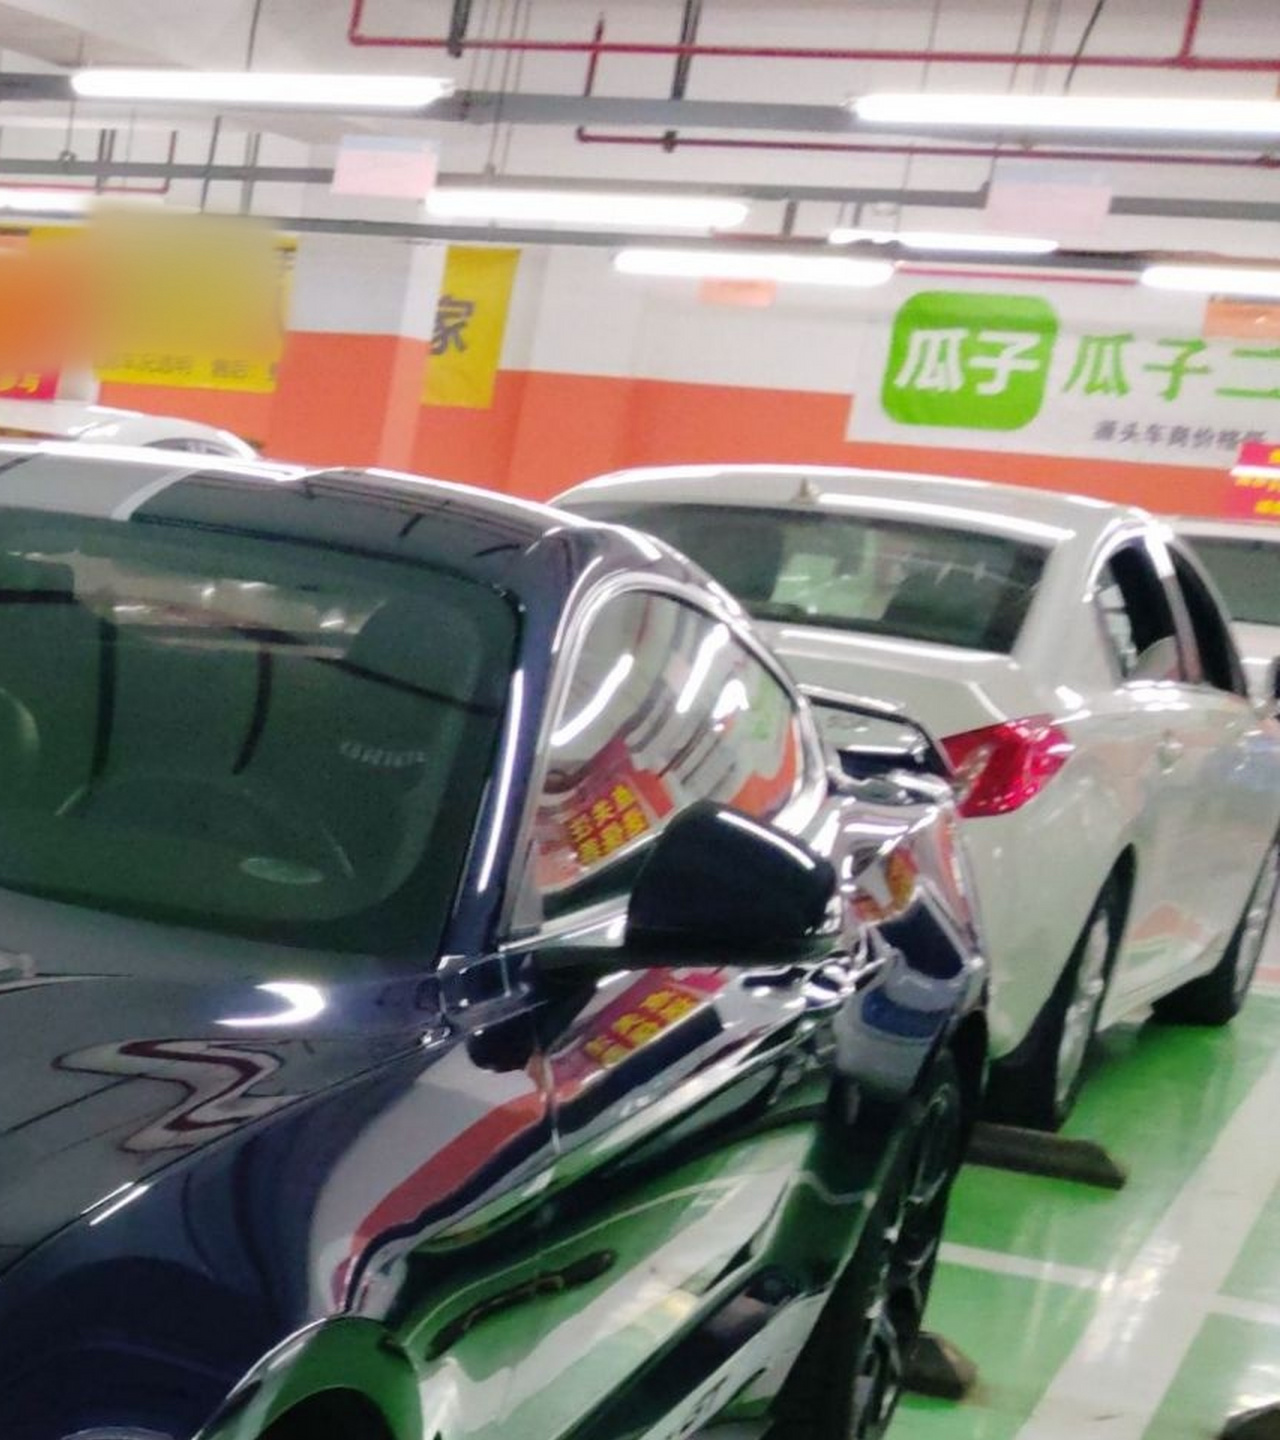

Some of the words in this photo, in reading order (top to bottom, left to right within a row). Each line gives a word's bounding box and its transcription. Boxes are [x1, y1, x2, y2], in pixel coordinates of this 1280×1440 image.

[430, 295, 475, 356] 家
[894, 328, 1041, 396] 瓜子
[1061, 332, 1280, 402] 瓜子二
